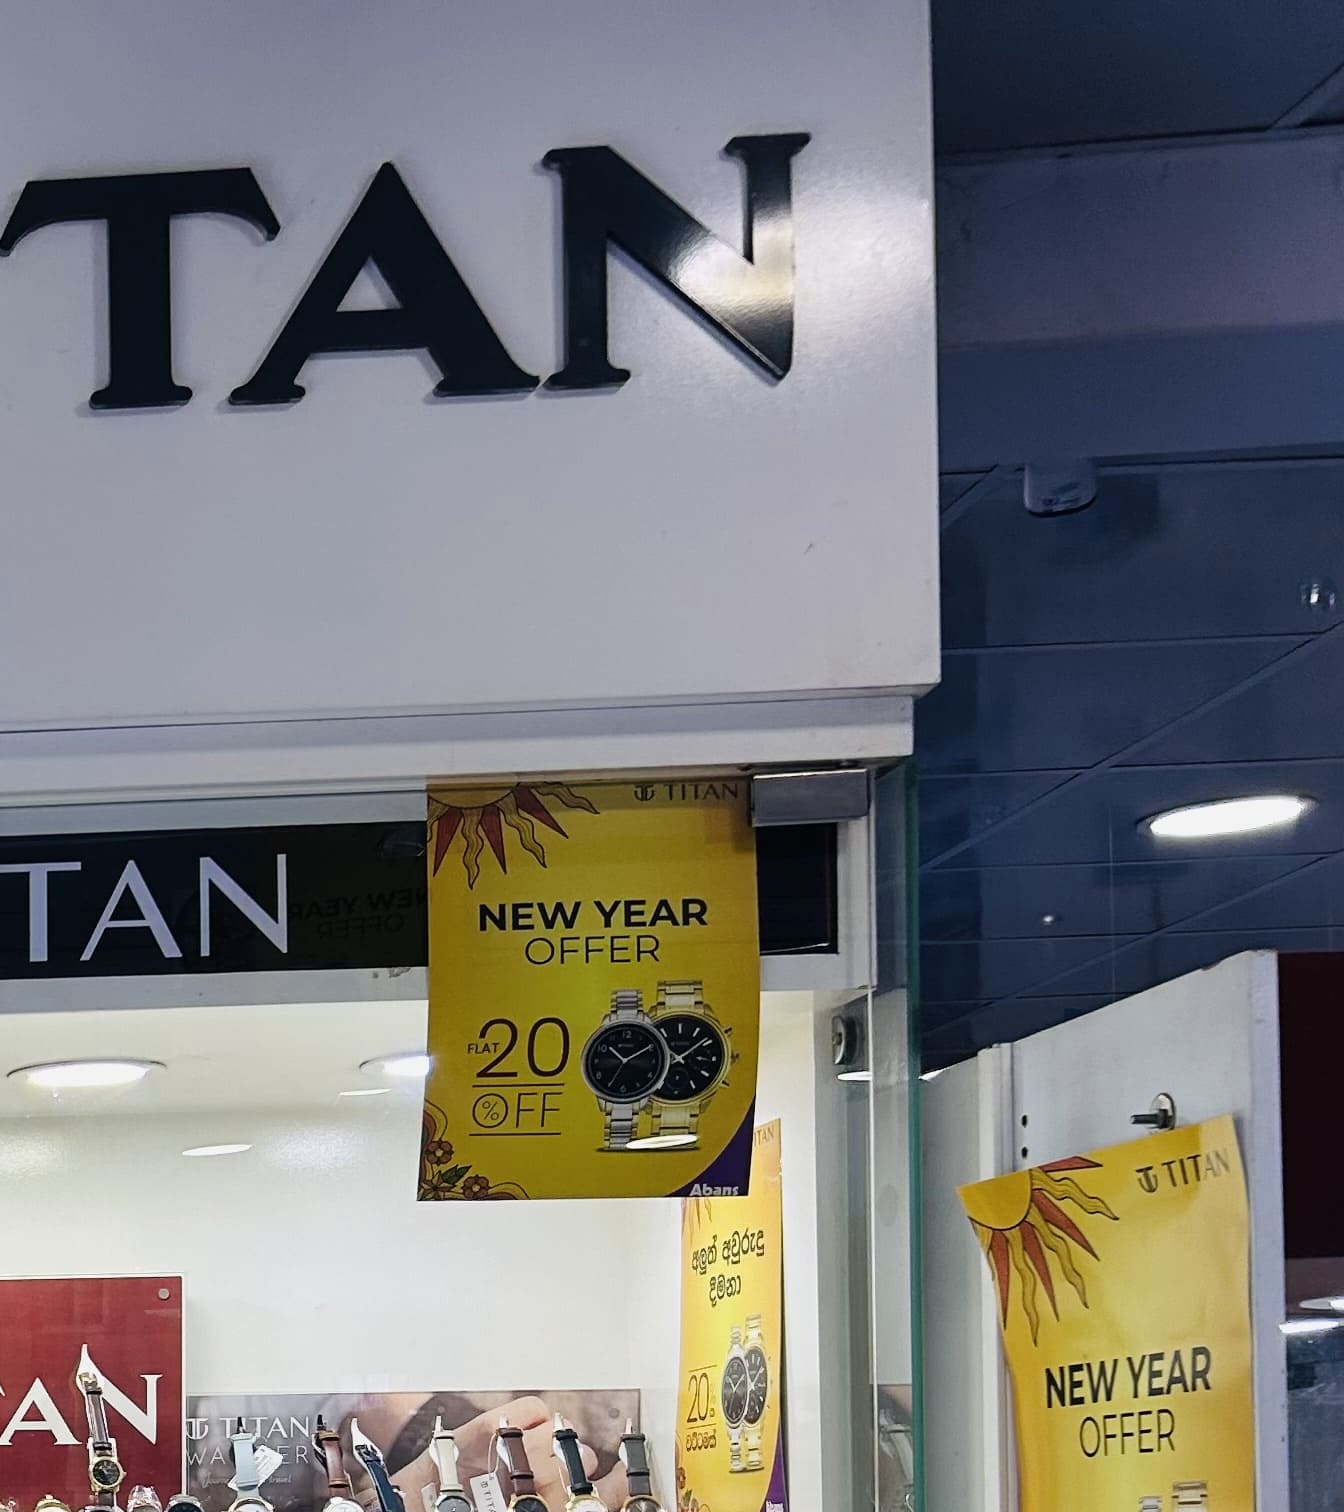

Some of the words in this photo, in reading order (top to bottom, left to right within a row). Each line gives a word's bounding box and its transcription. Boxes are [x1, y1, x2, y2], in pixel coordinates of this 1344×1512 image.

[664, 782, 739, 801] TITAN
[479, 900, 581, 932] NEW
[588, 898, 708, 929] YEAR
[524, 935, 660, 966] OFFER
[467, 1042, 500, 1055] FLAT
[476, 1016, 570, 1079] 20
[472, 1092, 561, 1130] OFF
[1162, 1148, 1230, 1189] TITAN
[690, 1183, 739, 1197] Abans
[1045, 1357, 1117, 1408] NEW
[1127, 1346, 1211, 1398] YEAR
[1079, 1409, 1176, 1458] OFFER
[187, 1445, 309, 1465] WAER
